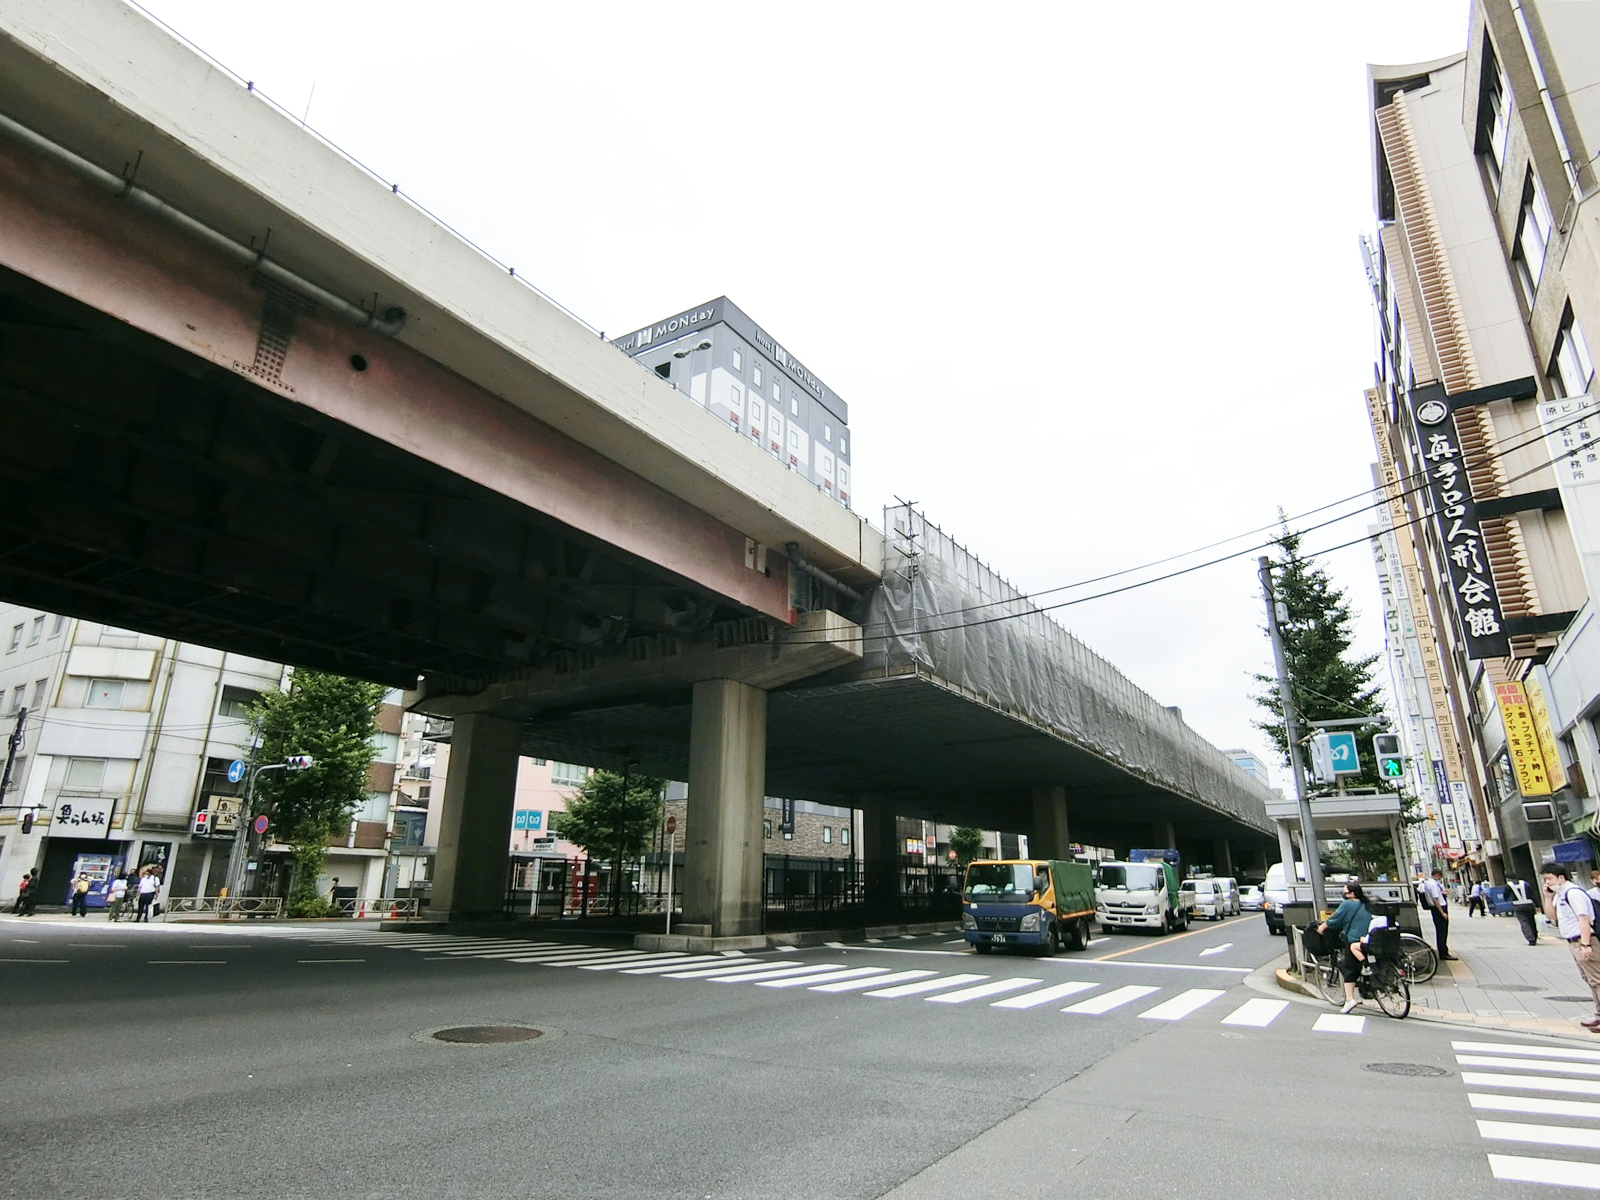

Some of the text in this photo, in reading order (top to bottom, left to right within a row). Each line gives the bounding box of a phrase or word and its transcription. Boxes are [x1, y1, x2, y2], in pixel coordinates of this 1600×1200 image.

[655, 308, 715, 339] MONday
[787, 359, 826, 398] MONday
[1546, 401, 1589, 416] 原ビル
[1496, 685, 1518, 695] 高価
[1501, 695, 1524, 705] 買取
